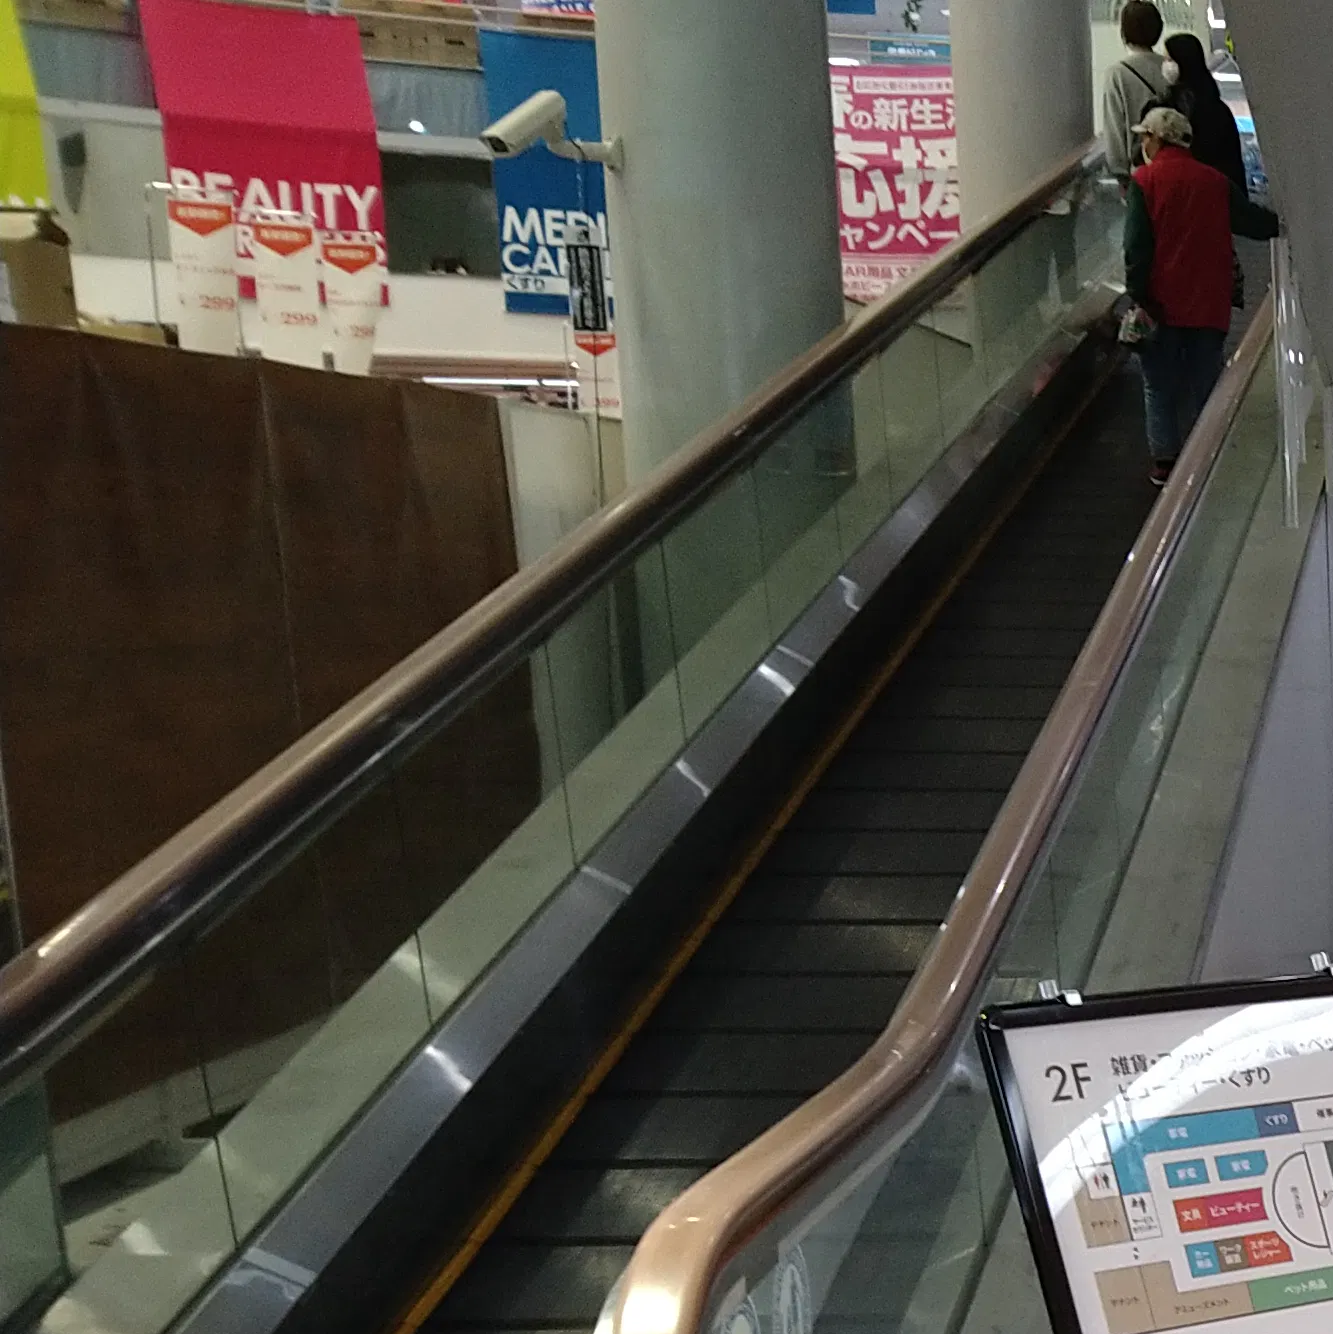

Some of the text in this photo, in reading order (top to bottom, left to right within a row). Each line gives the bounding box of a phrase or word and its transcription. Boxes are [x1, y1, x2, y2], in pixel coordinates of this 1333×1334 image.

[170, 167, 378, 231] BEAUTY
[1045, 1062, 1092, 1102] 2F
[1284, 1277, 1328, 1295] ペット用品
